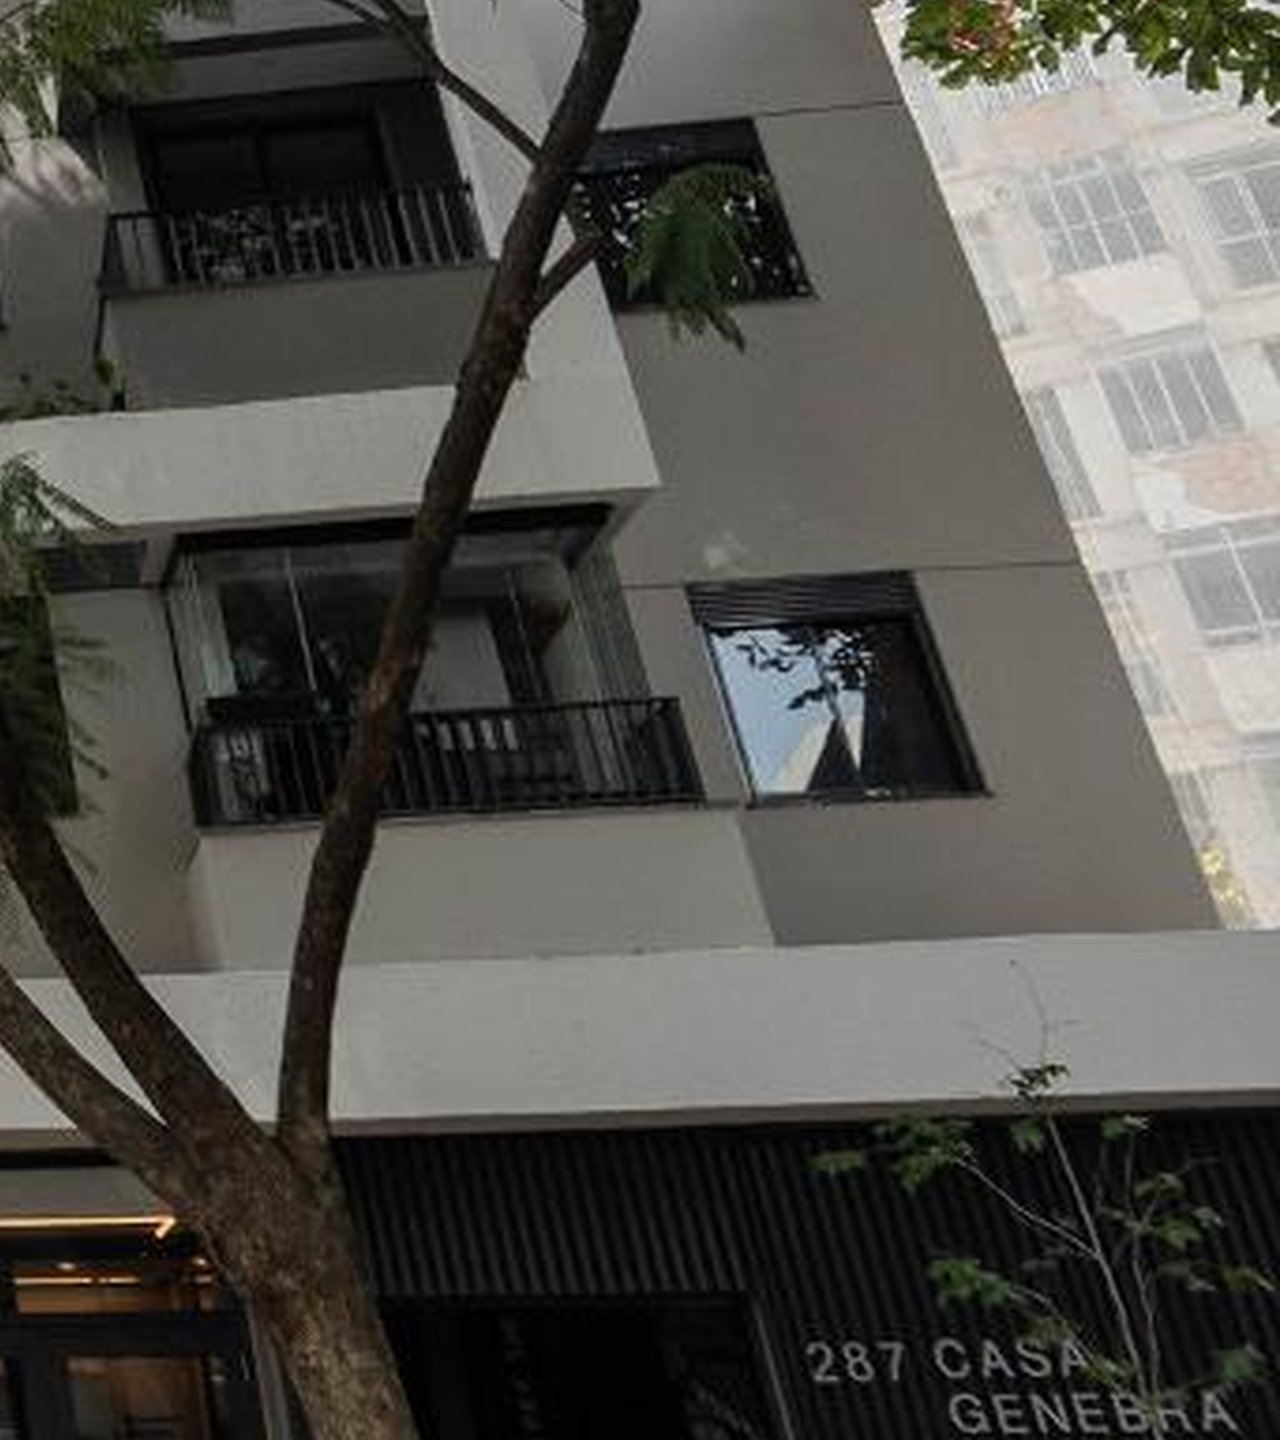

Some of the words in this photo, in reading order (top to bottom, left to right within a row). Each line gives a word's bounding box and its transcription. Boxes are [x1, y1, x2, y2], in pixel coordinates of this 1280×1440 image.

[805, 1341, 905, 1383] 287
[933, 1337, 1090, 1379] CASA
[948, 1391, 1239, 1435] GENEBRA
